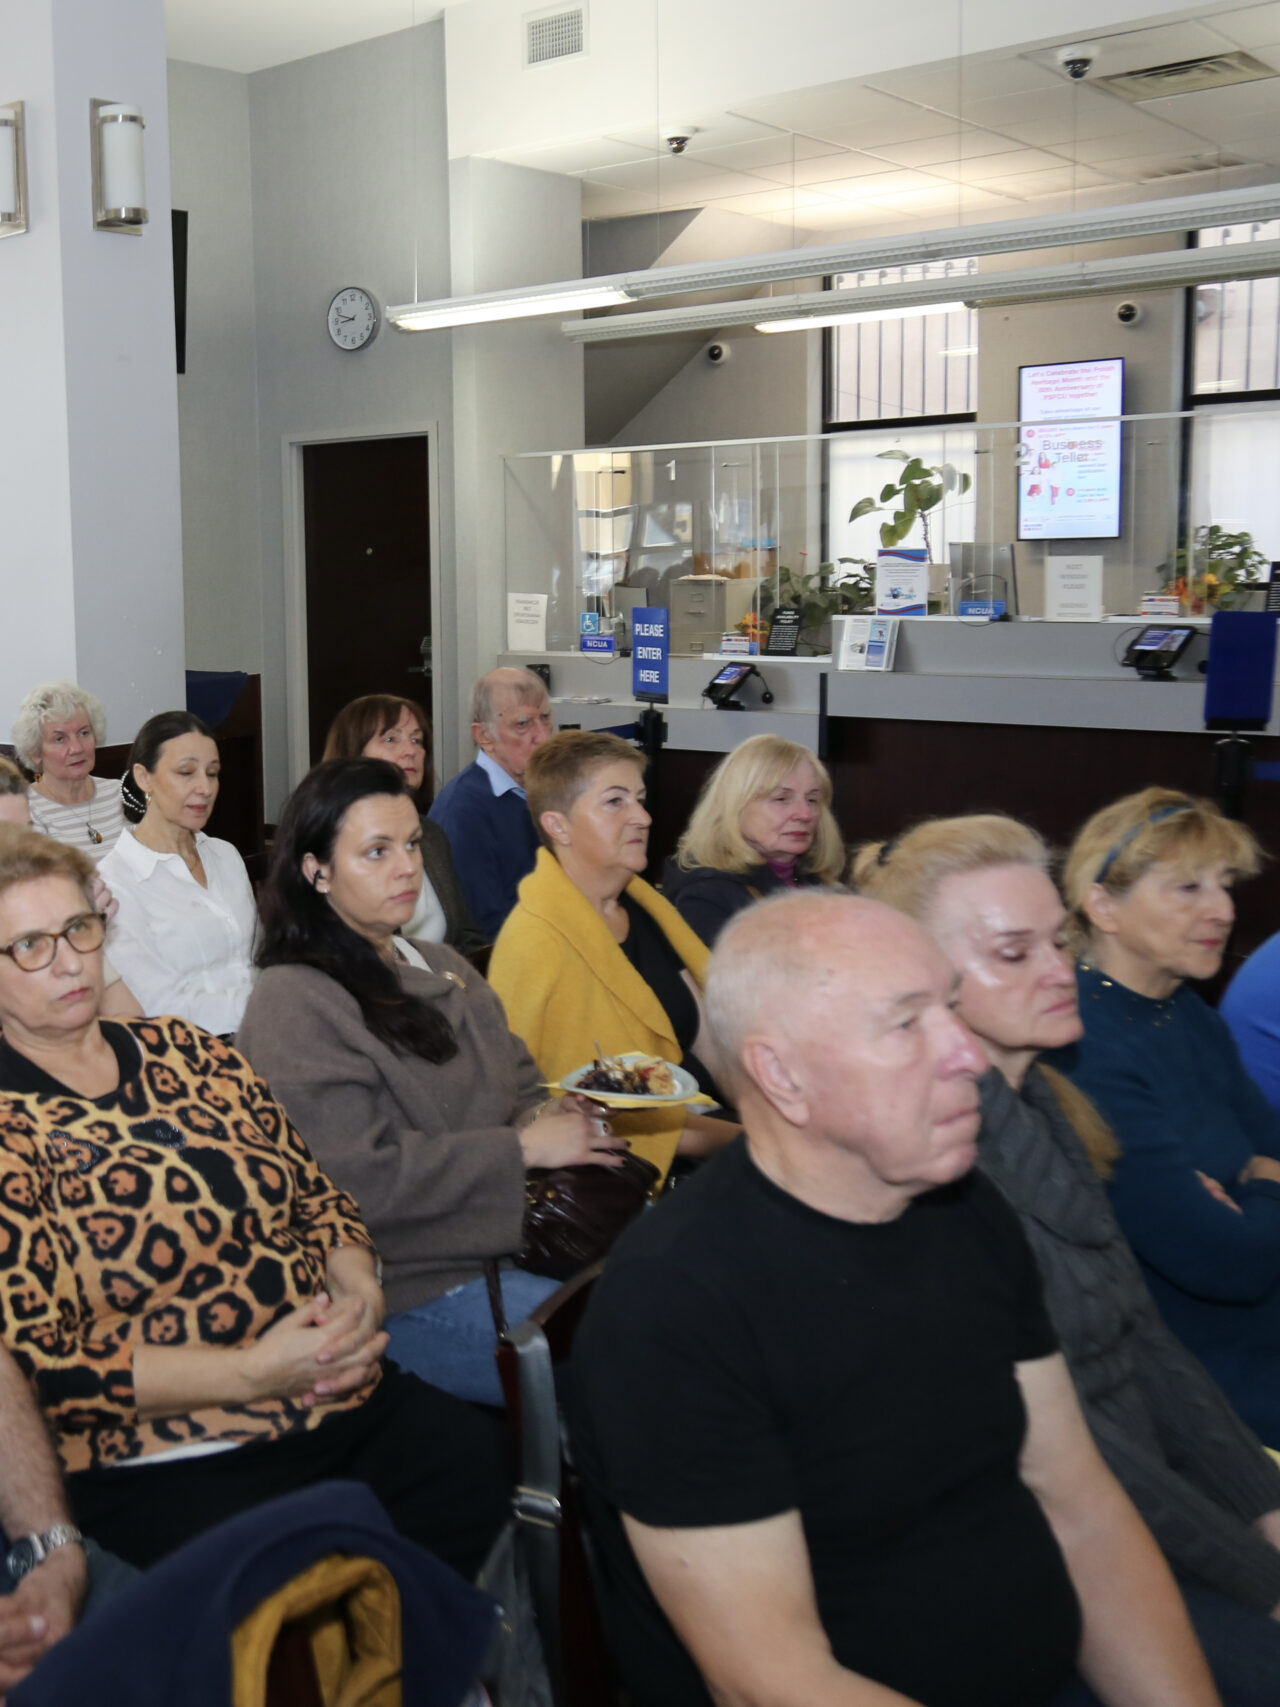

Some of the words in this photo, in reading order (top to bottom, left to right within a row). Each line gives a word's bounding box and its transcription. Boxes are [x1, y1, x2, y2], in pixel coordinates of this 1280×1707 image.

[1014, 442, 1031, 467] 2
[665, 459, 676, 481] 1
[967, 606, 995, 616] NCUA
[635, 623, 664, 638] PLEASE
[586, 640, 608, 648] NCUA
[636, 646, 662, 661] ENTER
[639, 669, 660, 684] HERE
